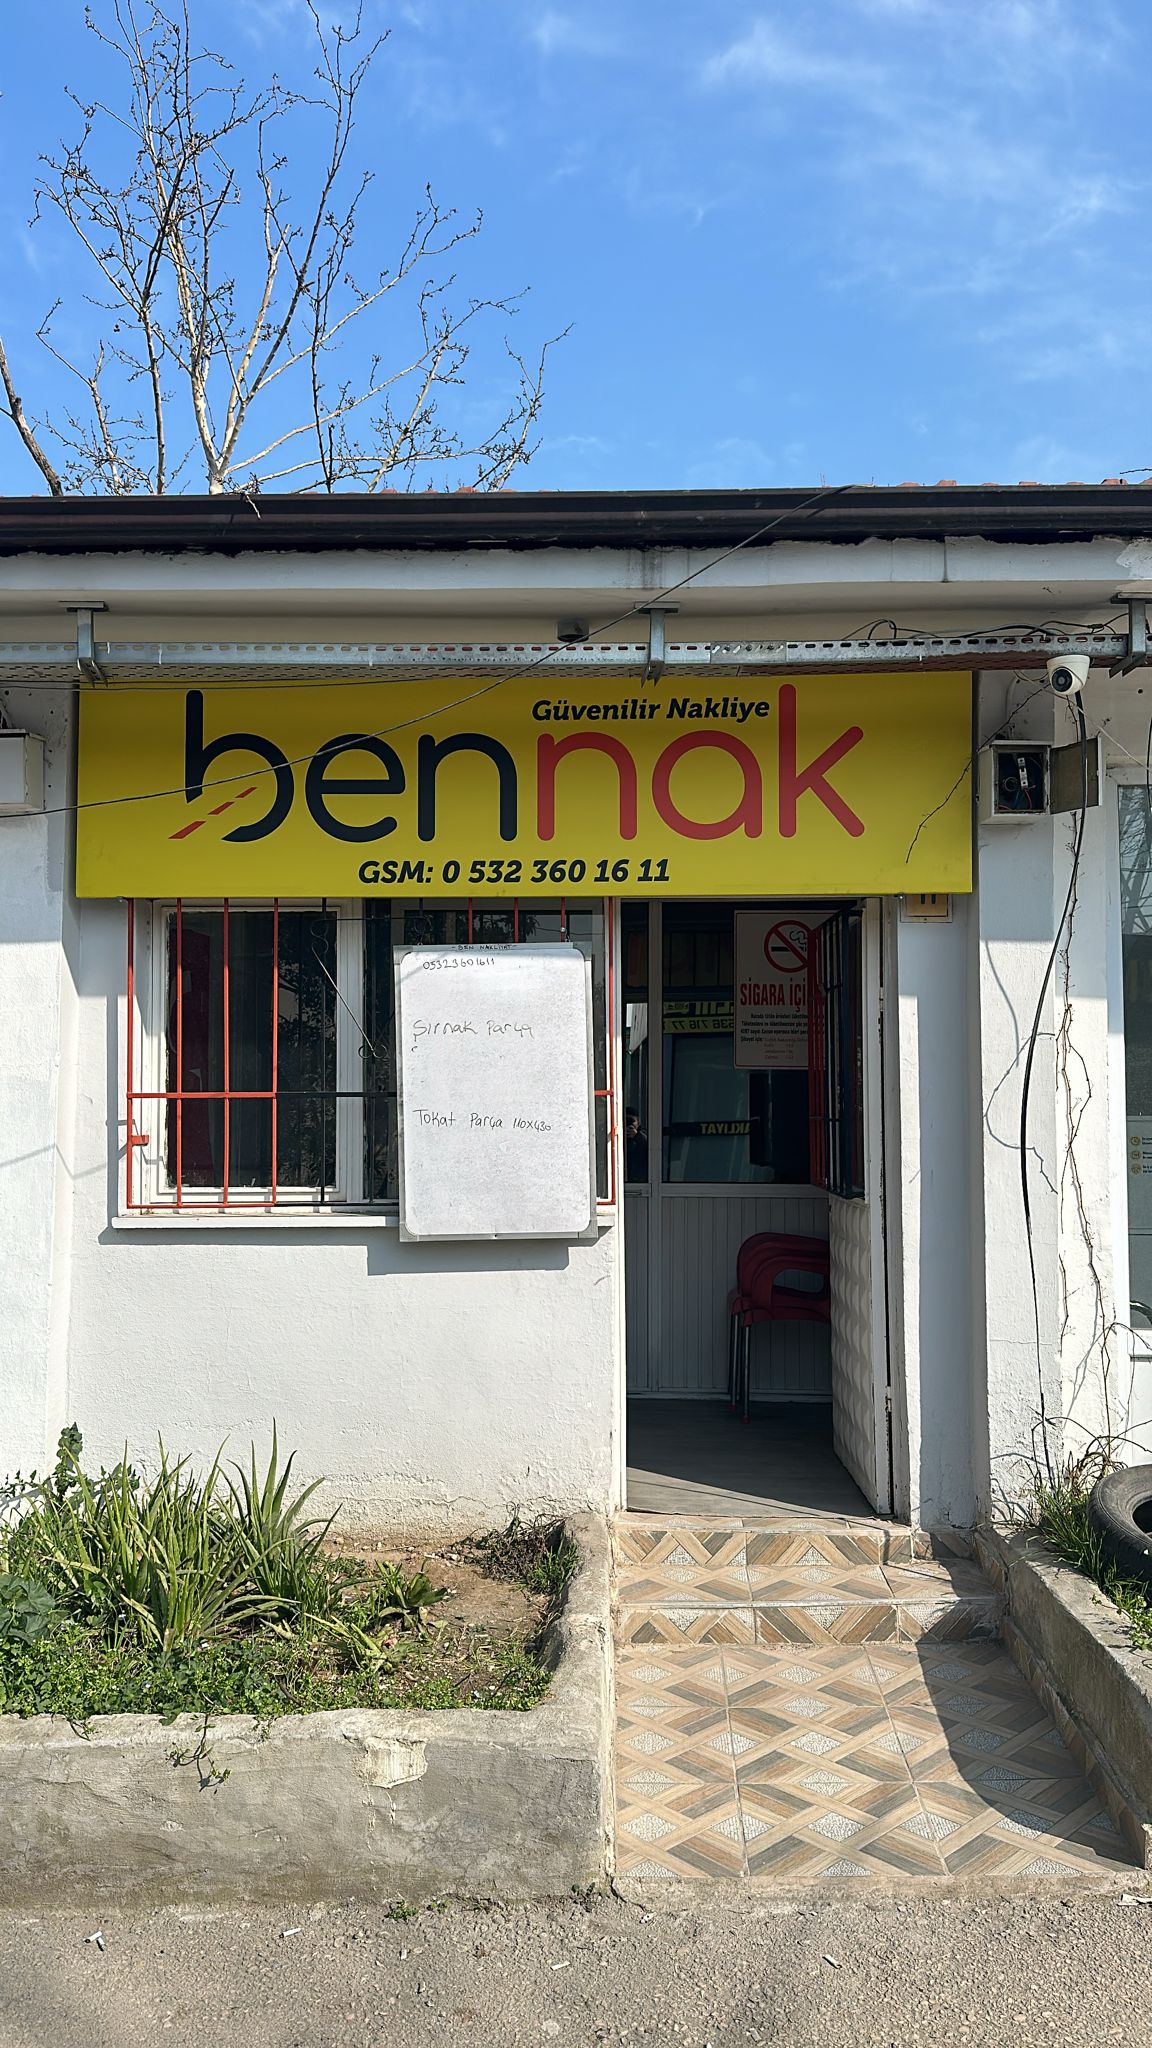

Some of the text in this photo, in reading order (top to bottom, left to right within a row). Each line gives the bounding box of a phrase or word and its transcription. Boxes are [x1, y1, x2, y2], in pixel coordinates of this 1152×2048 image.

[531, 697, 771, 724] Güvenilir Nakliye
[169, 683, 865, 842] bennak
[358, 857, 670, 884] GSM: 0 532 360 16 11
[740, 977, 785, 1006] SİGARA
